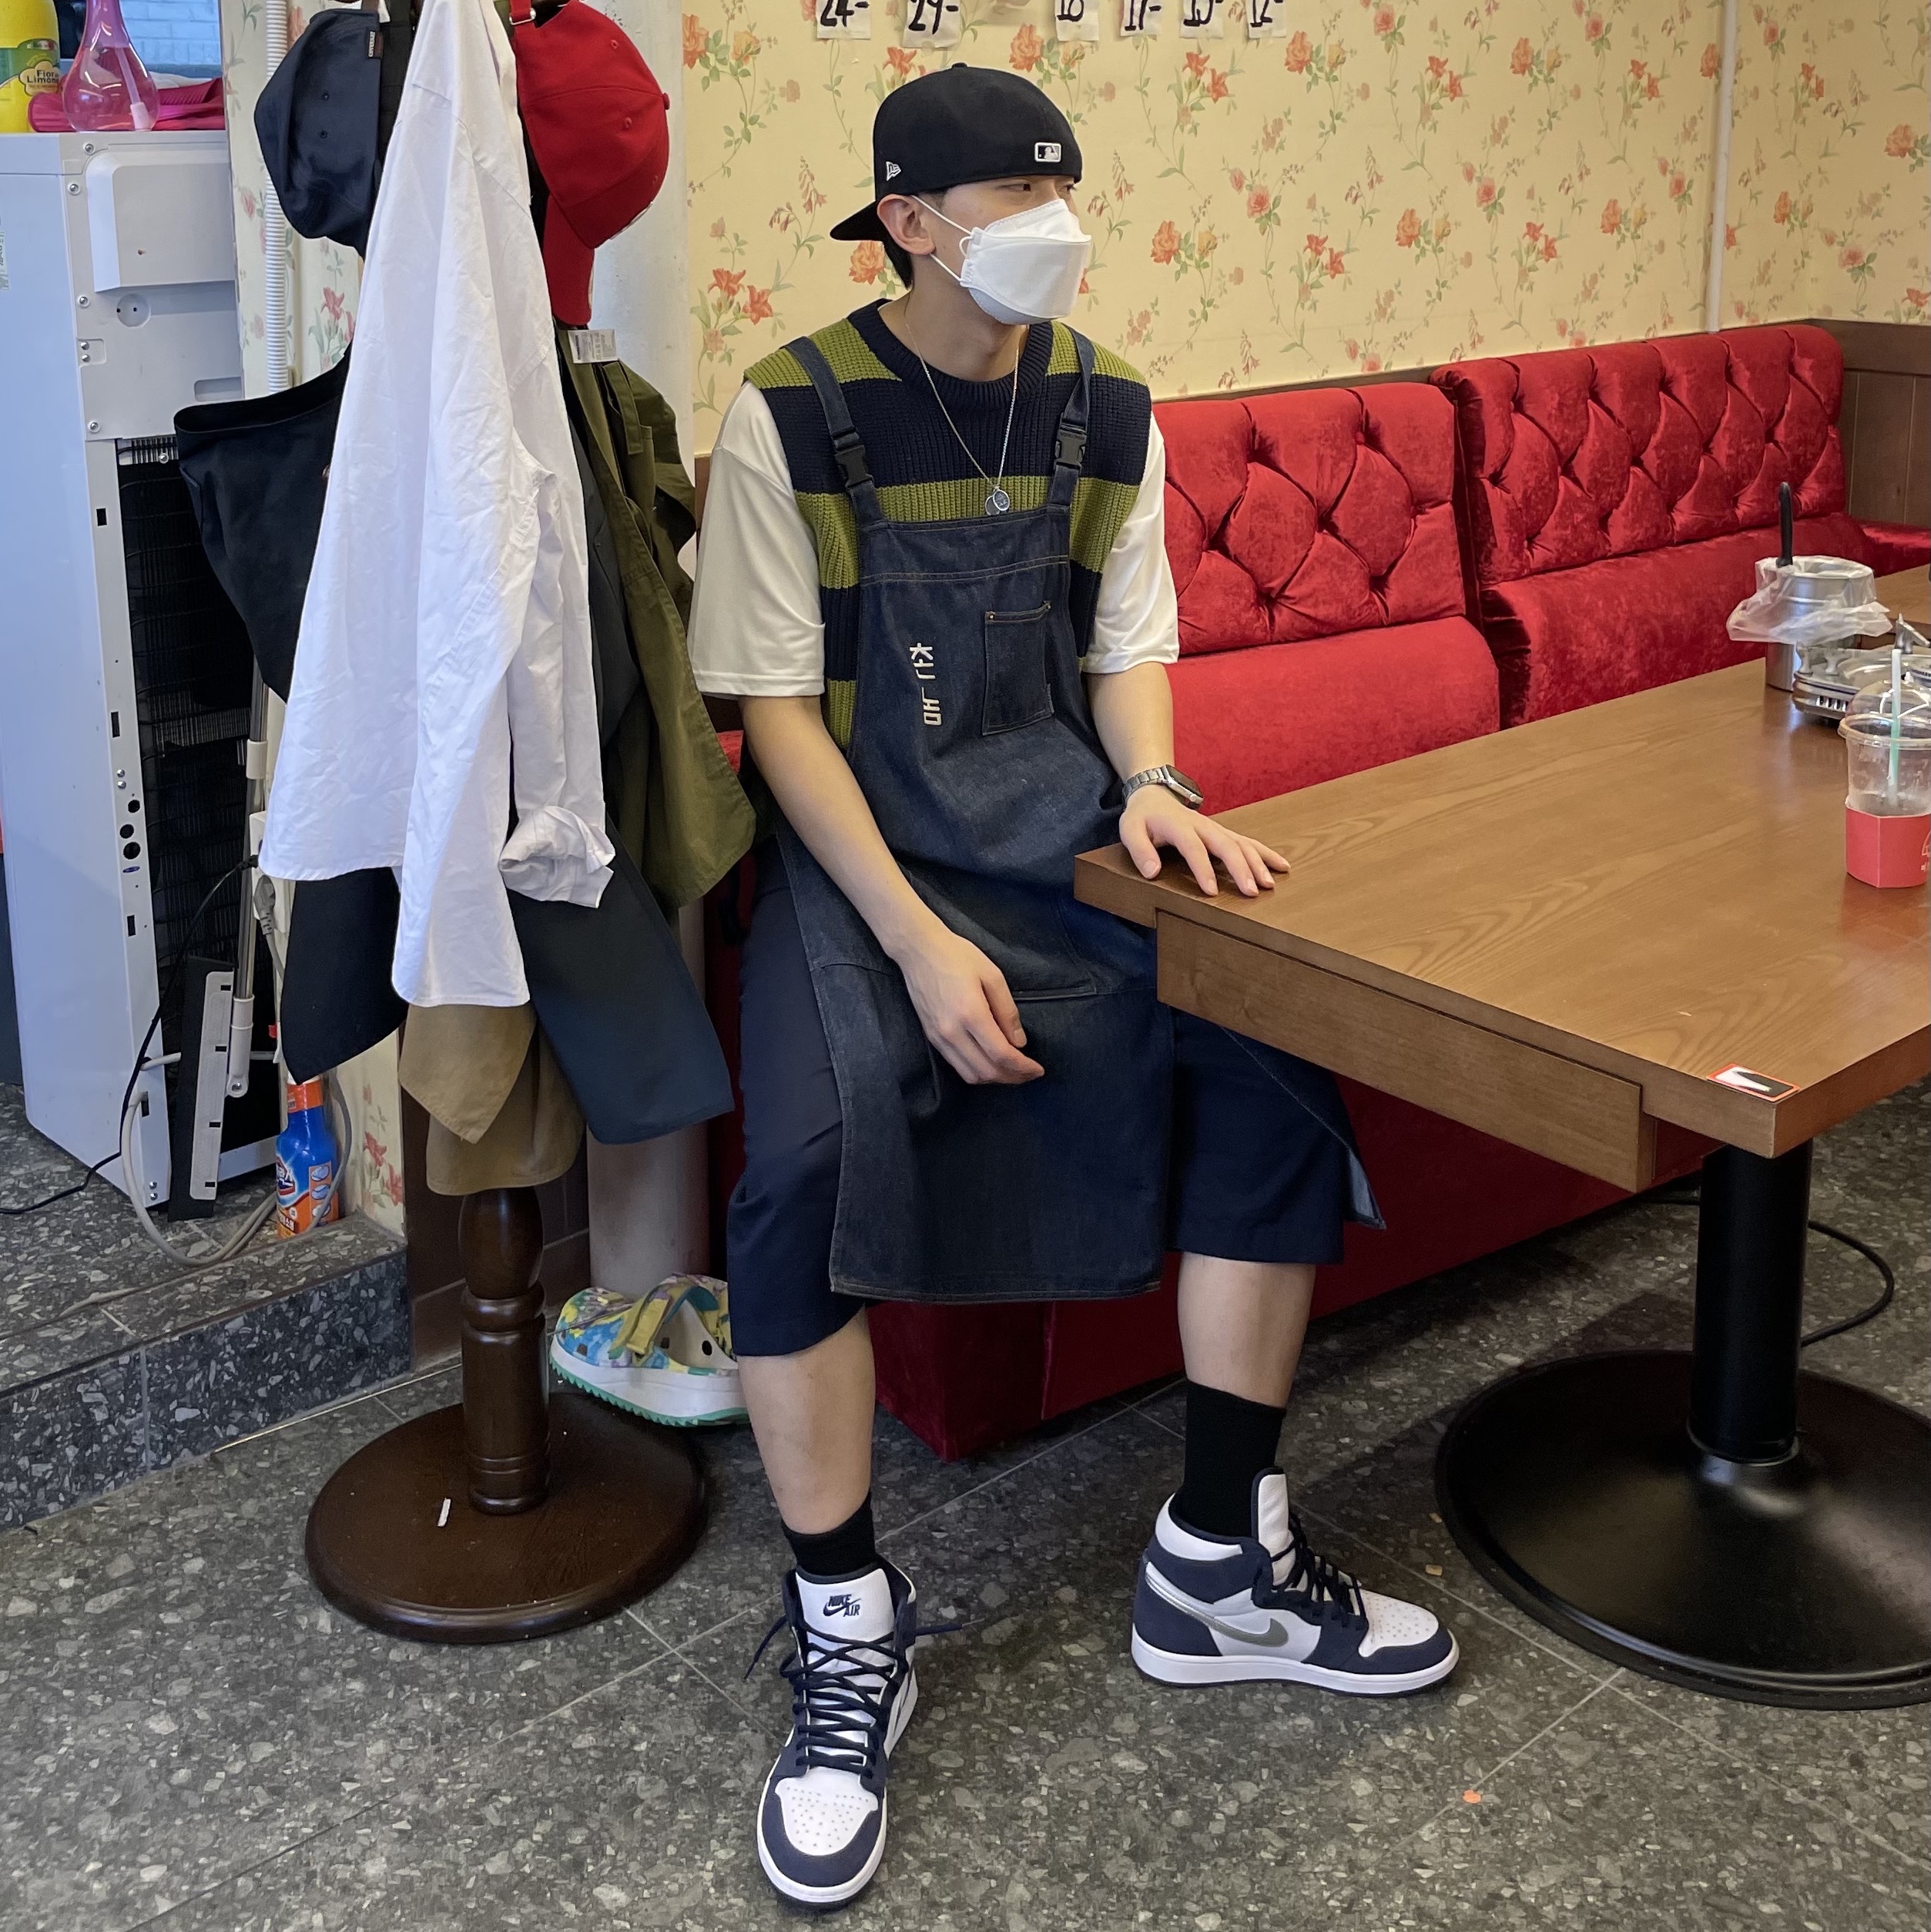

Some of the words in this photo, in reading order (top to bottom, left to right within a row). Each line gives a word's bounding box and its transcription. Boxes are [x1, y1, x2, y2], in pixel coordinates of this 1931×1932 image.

[909, 642, 943, 726] 촌놈
[827, 1594, 852, 1607] NIKE
[843, 1603, 861, 1618] AIR
